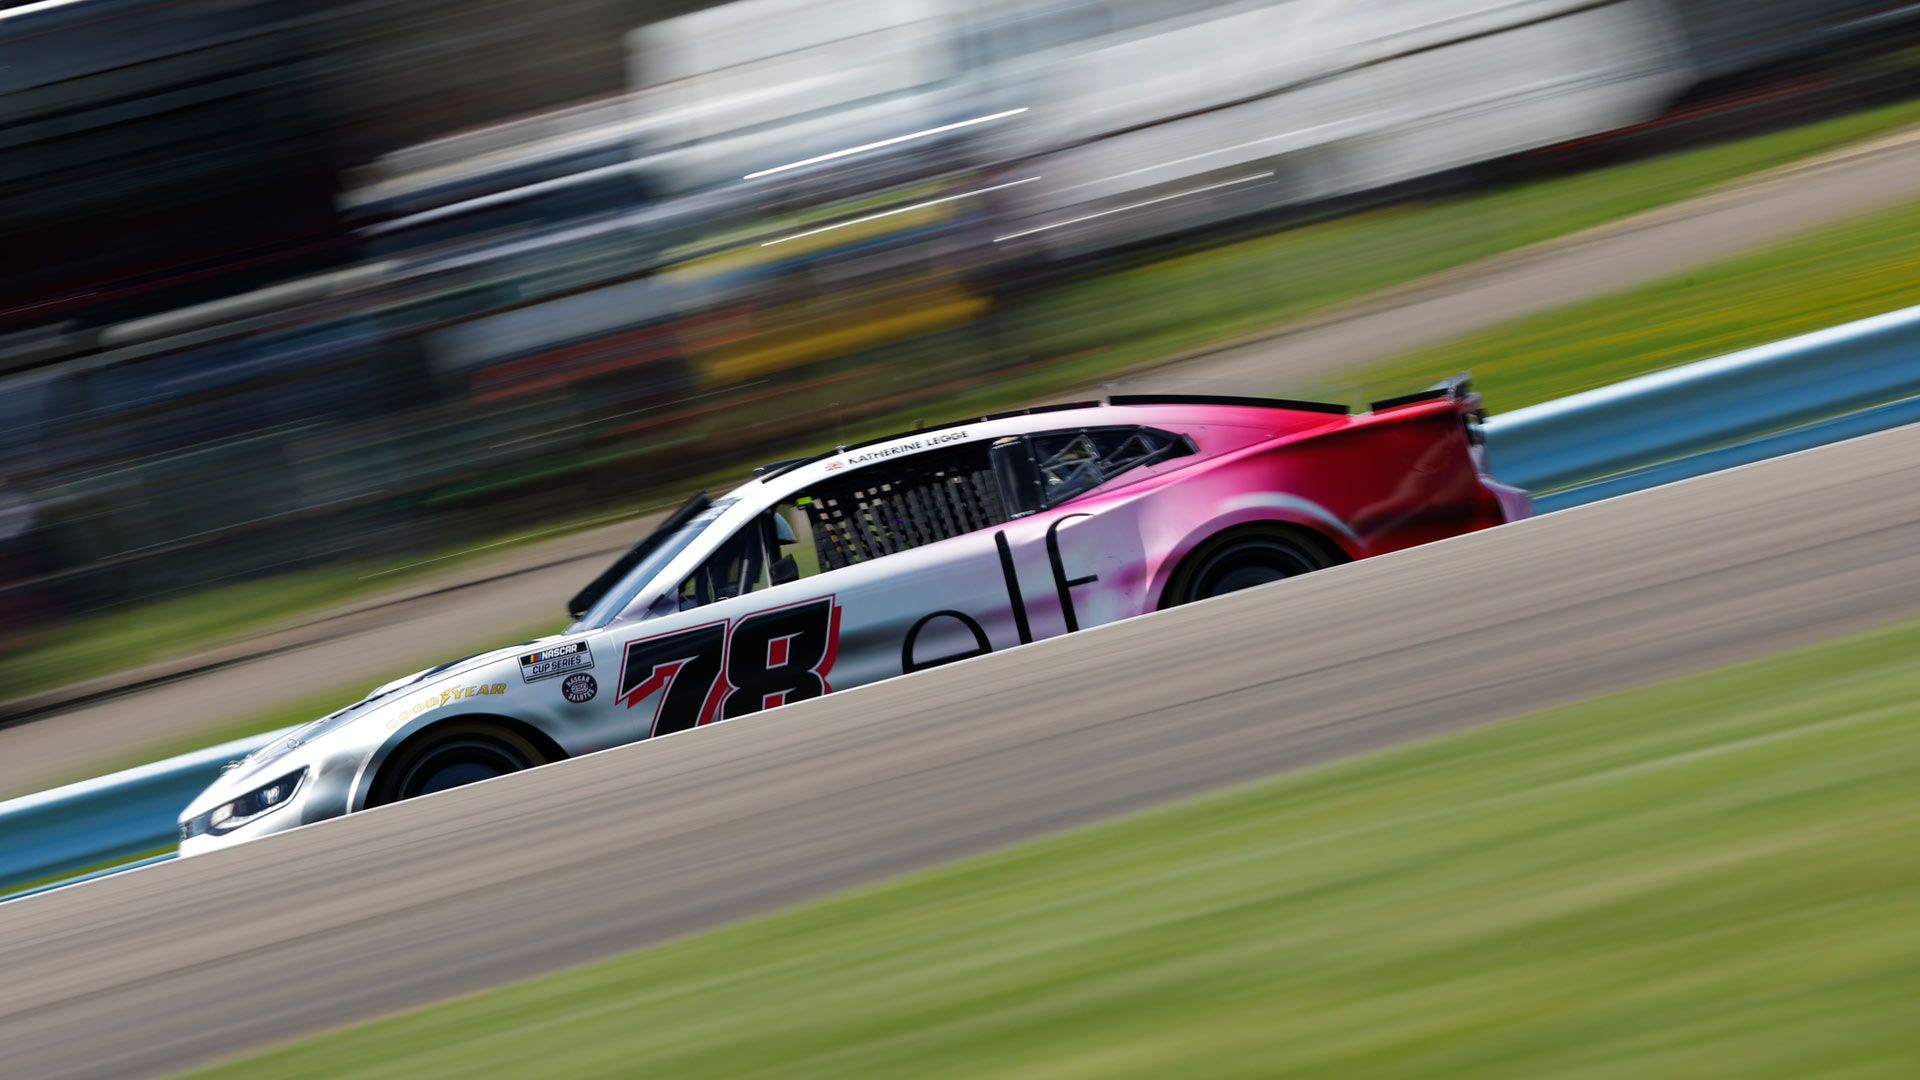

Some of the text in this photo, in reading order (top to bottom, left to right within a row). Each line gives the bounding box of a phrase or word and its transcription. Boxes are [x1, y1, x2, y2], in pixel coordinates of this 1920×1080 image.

[848, 440, 922, 465] KATHERINE
[925, 430, 969, 447] LEGGE
[532, 655, 582, 675] CUP SERIES
[541, 644, 578, 660] NASCAR
[615, 593, 842, 739] 78
[386, 683, 507, 730] GOODYEAR
